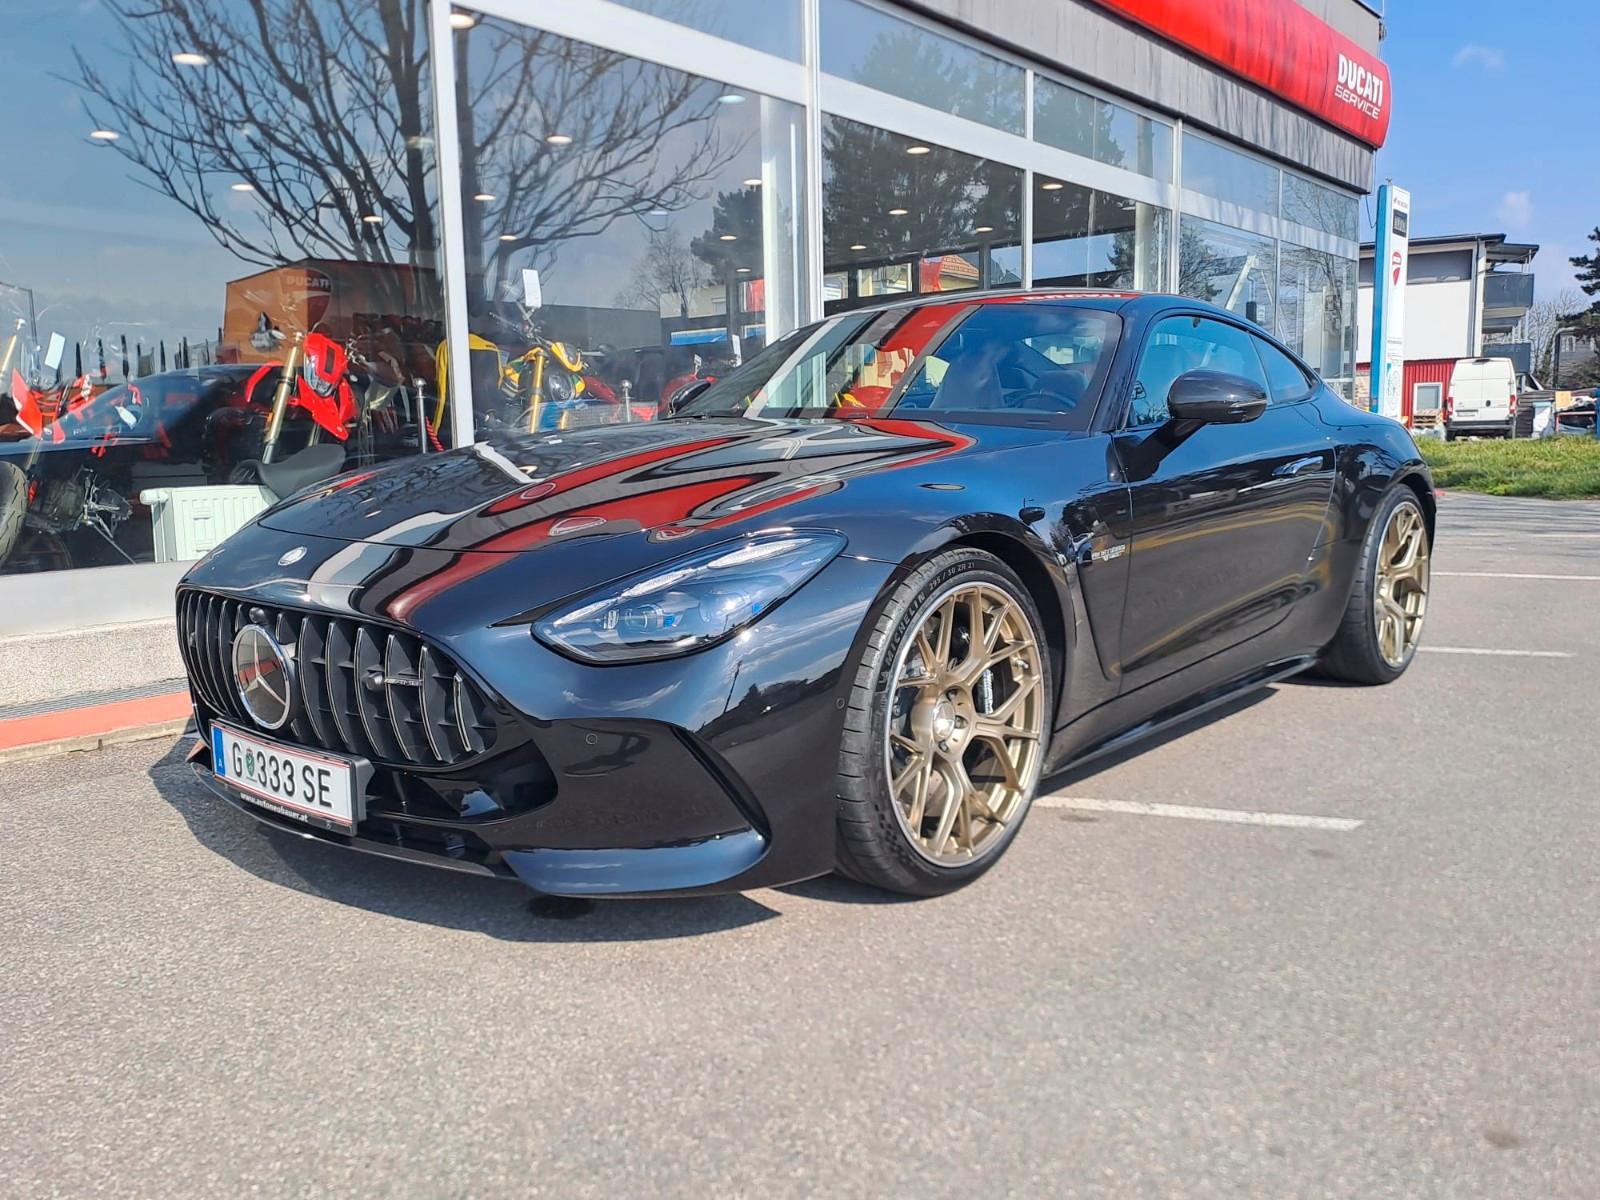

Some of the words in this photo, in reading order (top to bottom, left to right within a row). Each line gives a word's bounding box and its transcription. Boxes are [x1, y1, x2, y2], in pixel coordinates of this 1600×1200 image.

[1334, 84, 1381, 120] SERVICE
[1338, 53, 1383, 107] DUCATI
[286, 275, 330, 289] DUCATI
[232, 741, 243, 778] G
[256, 751, 295, 797] 333
[302, 765, 333, 809] SE
